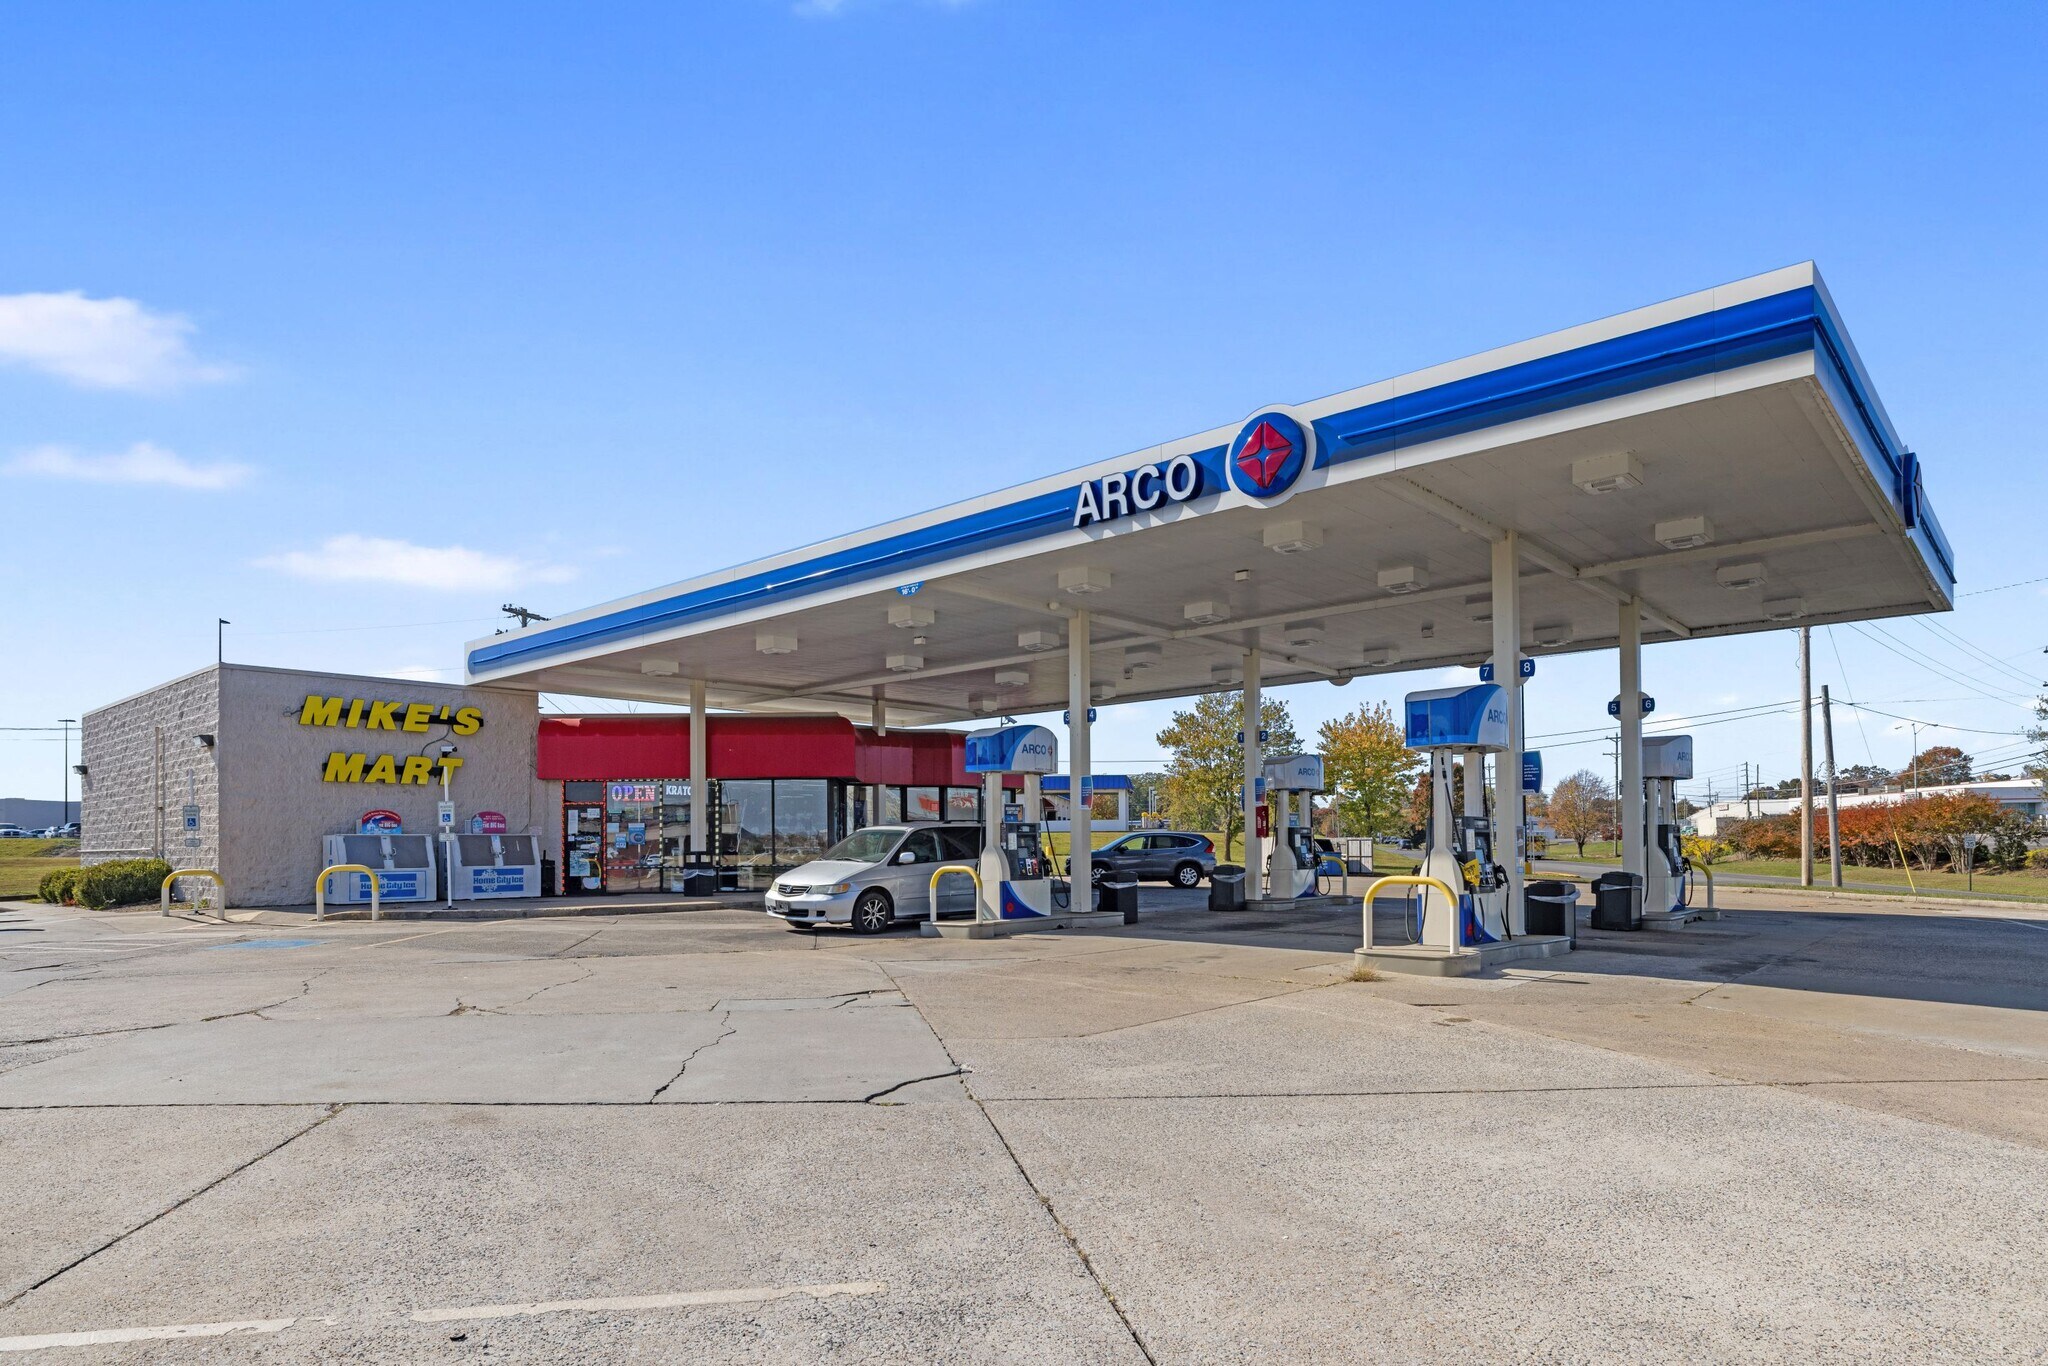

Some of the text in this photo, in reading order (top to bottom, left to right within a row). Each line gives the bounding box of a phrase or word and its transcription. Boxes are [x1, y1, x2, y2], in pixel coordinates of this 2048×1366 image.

[1073, 454, 1197, 527] ARCO
[1483, 667, 1490, 677] 7
[1523, 662, 1531, 673] 8
[1611, 704, 1617, 712] 5
[1645, 700, 1652, 709] 6
[299, 695, 482, 736] MIKE'S
[1089, 711, 1095, 719] 4
[1261, 732, 1267, 740] 2
[1022, 744, 1047, 756] ARCO
[323, 752, 464, 786] MART
[1298, 767, 1316, 777] ARCO
[611, 785, 656, 801] OPEN
[473, 877, 496, 885] Home
[496, 876, 512, 885] City
[360, 882, 386, 890] Hoe
[386, 882, 403, 891] City
